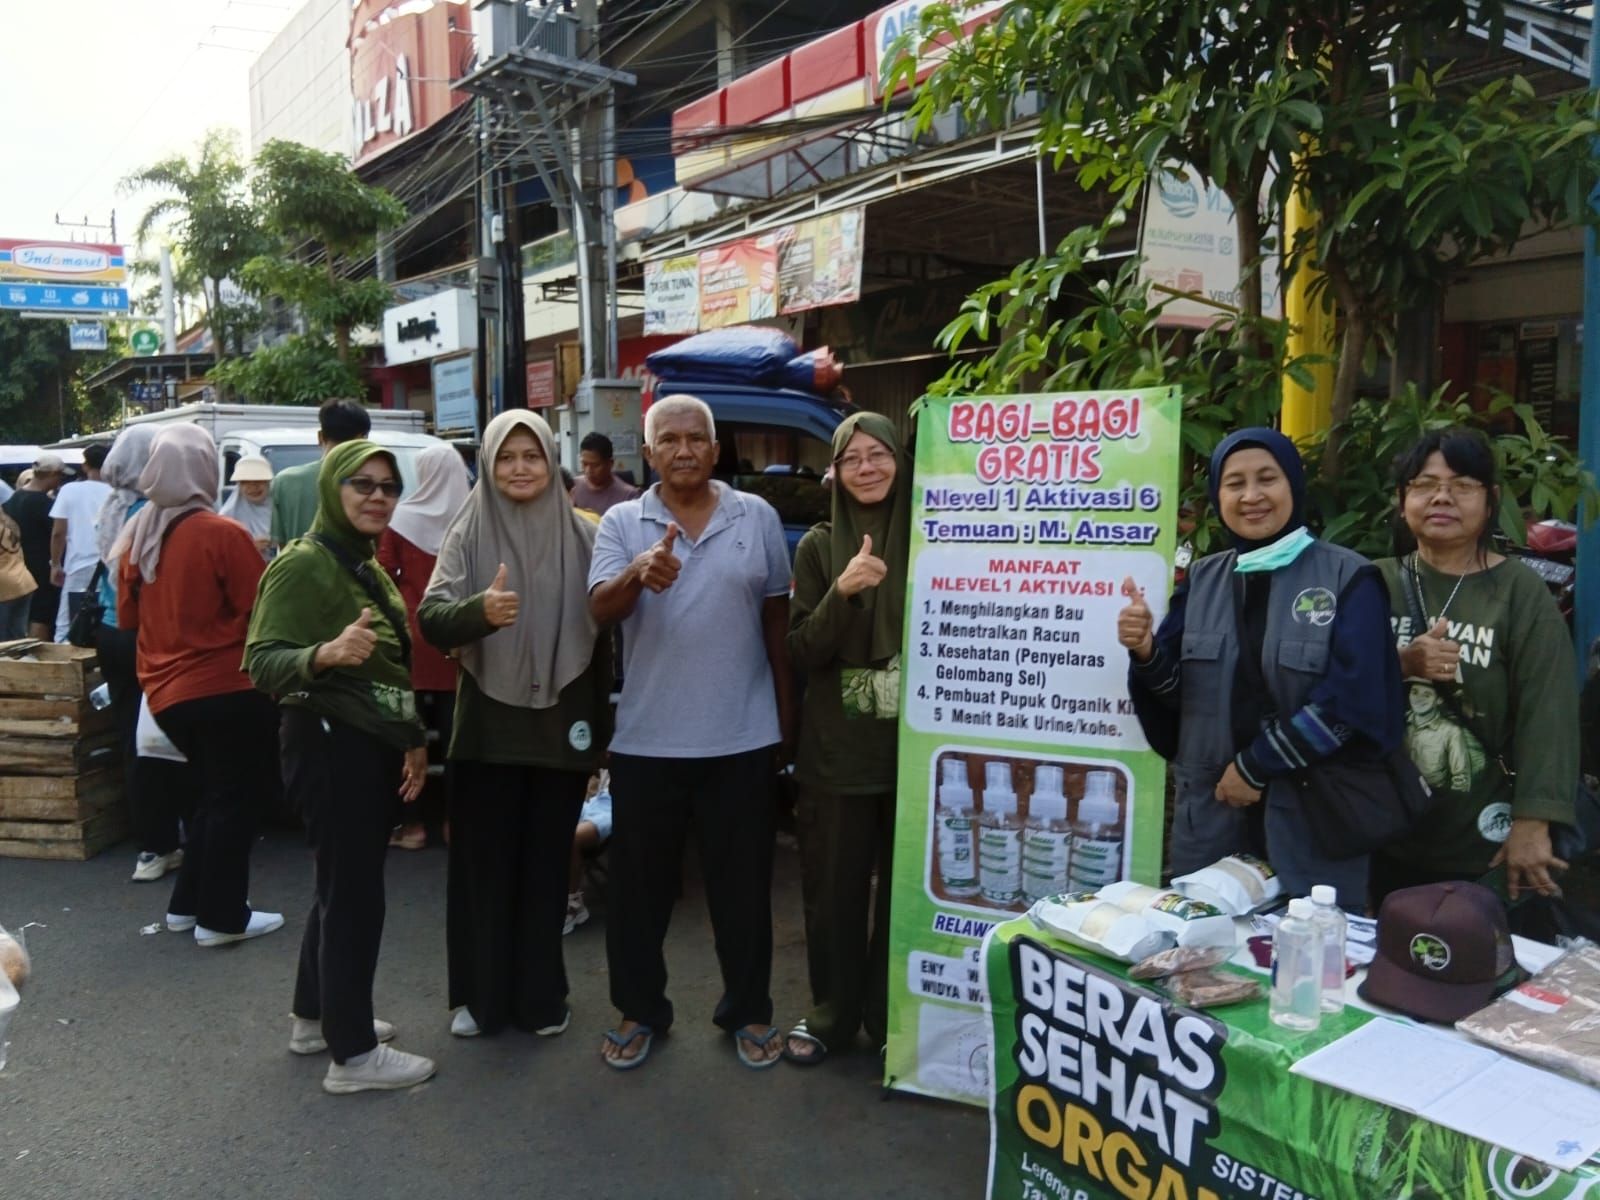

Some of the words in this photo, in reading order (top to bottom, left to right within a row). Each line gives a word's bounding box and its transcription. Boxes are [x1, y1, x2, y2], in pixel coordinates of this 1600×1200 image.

[950, 398, 1140, 441] BAGI-BAGI
[978, 444, 1102, 481] GRATIS
[925, 489, 994, 507] Nlevel
[1004, 489, 1016, 506] 1
[1025, 487, 1130, 507] Aktivasi
[1139, 488, 1158, 507] 6
[924, 520, 1015, 539] Temuan
[1039, 520, 1068, 539] M.
[1075, 520, 1158, 541] Ansar
[989, 559, 1081, 575] MANFAAT
[931, 577, 1012, 593] NLEVEL1
[1019, 578, 1113, 597] AKTIVASI
[923, 600, 935, 615] 1.
[940, 600, 1049, 622] Menghilangkan
[1054, 604, 1084, 621] Bau
[921, 621, 934, 636] 2.
[938, 622, 1027, 641] Menetralkan
[1032, 627, 1080, 643] Racun
[920, 643, 932, 657] 3.
[937, 643, 1010, 662] Kesehatan
[1015, 647, 1105, 668] (Penyelaras
[936, 665, 1012, 686] Gelombang
[1018, 669, 1046, 689] Sel)
[917, 686, 930, 701] 4.
[935, 686, 996, 705] Pembuat
[1000, 691, 1046, 710] Pupuk
[1050, 694, 1111, 715] Organik
[934, 707, 942, 722] 5
[951, 708, 992, 726] Menit
[997, 711, 1028, 729] Baik
[1034, 716, 1123, 738] Urine/kohe.
[921, 960, 945, 976] ENY
[921, 979, 960, 999] WIDYA
[1019, 944, 1215, 1090] BERAS
[1019, 1013, 1208, 1167] SEHAT
[1016, 1084, 1219, 1200] ORGA
